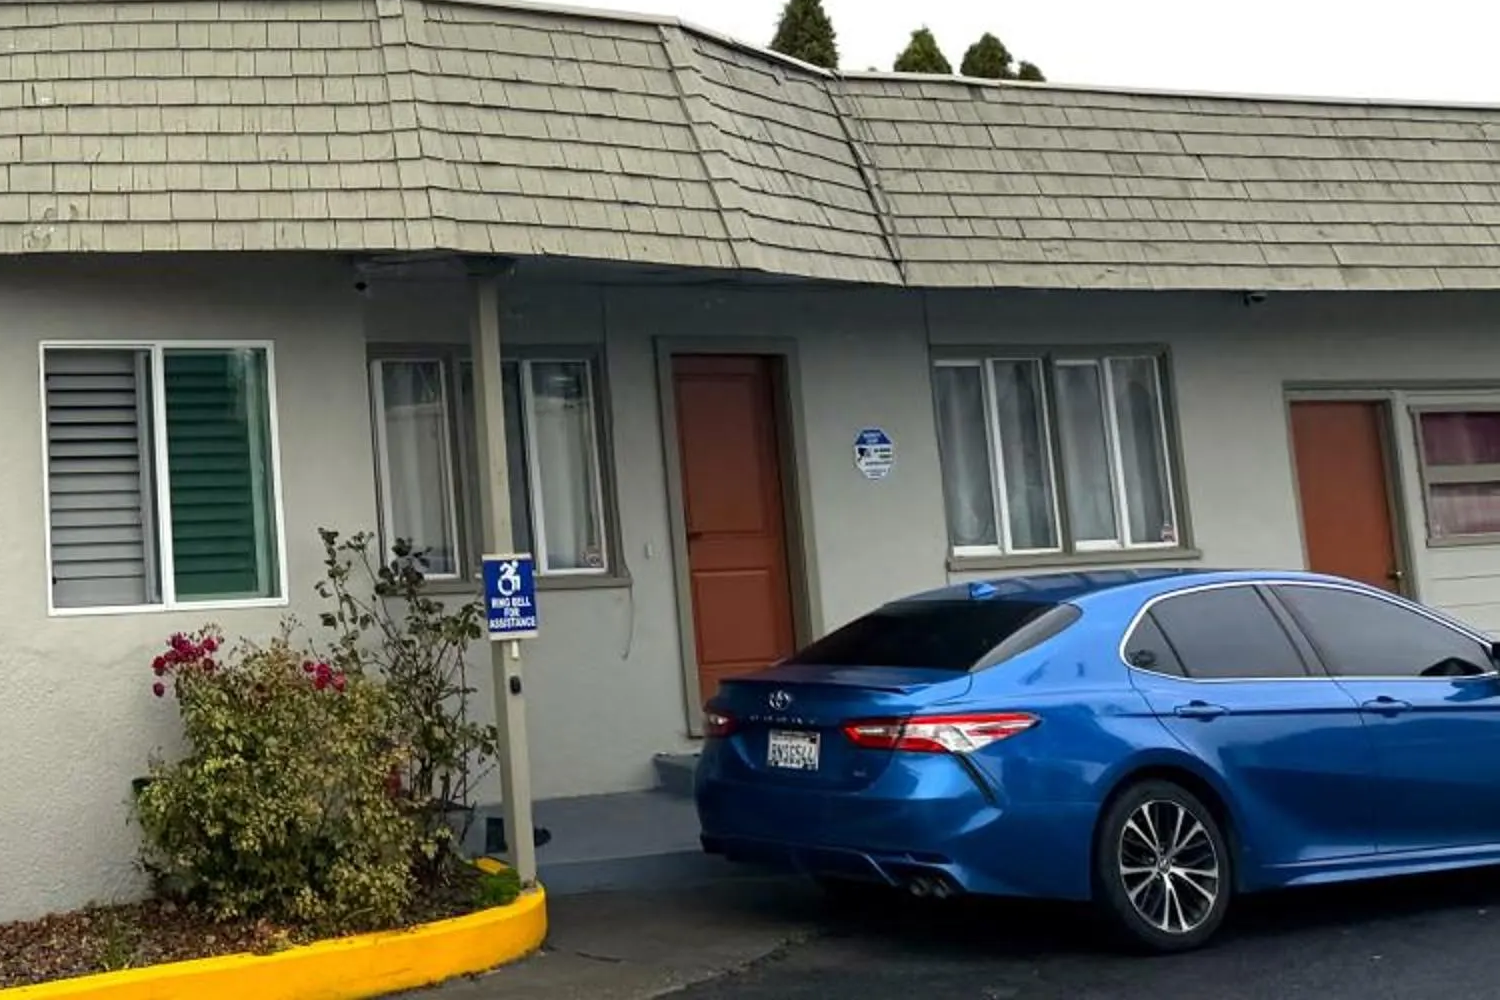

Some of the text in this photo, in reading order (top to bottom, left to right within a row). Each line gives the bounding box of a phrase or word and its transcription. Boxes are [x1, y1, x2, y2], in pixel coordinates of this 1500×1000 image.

[511, 596, 532, 607] BELL
[503, 607, 520, 617] FOR
[489, 616, 536, 629] ASSISTANCE
